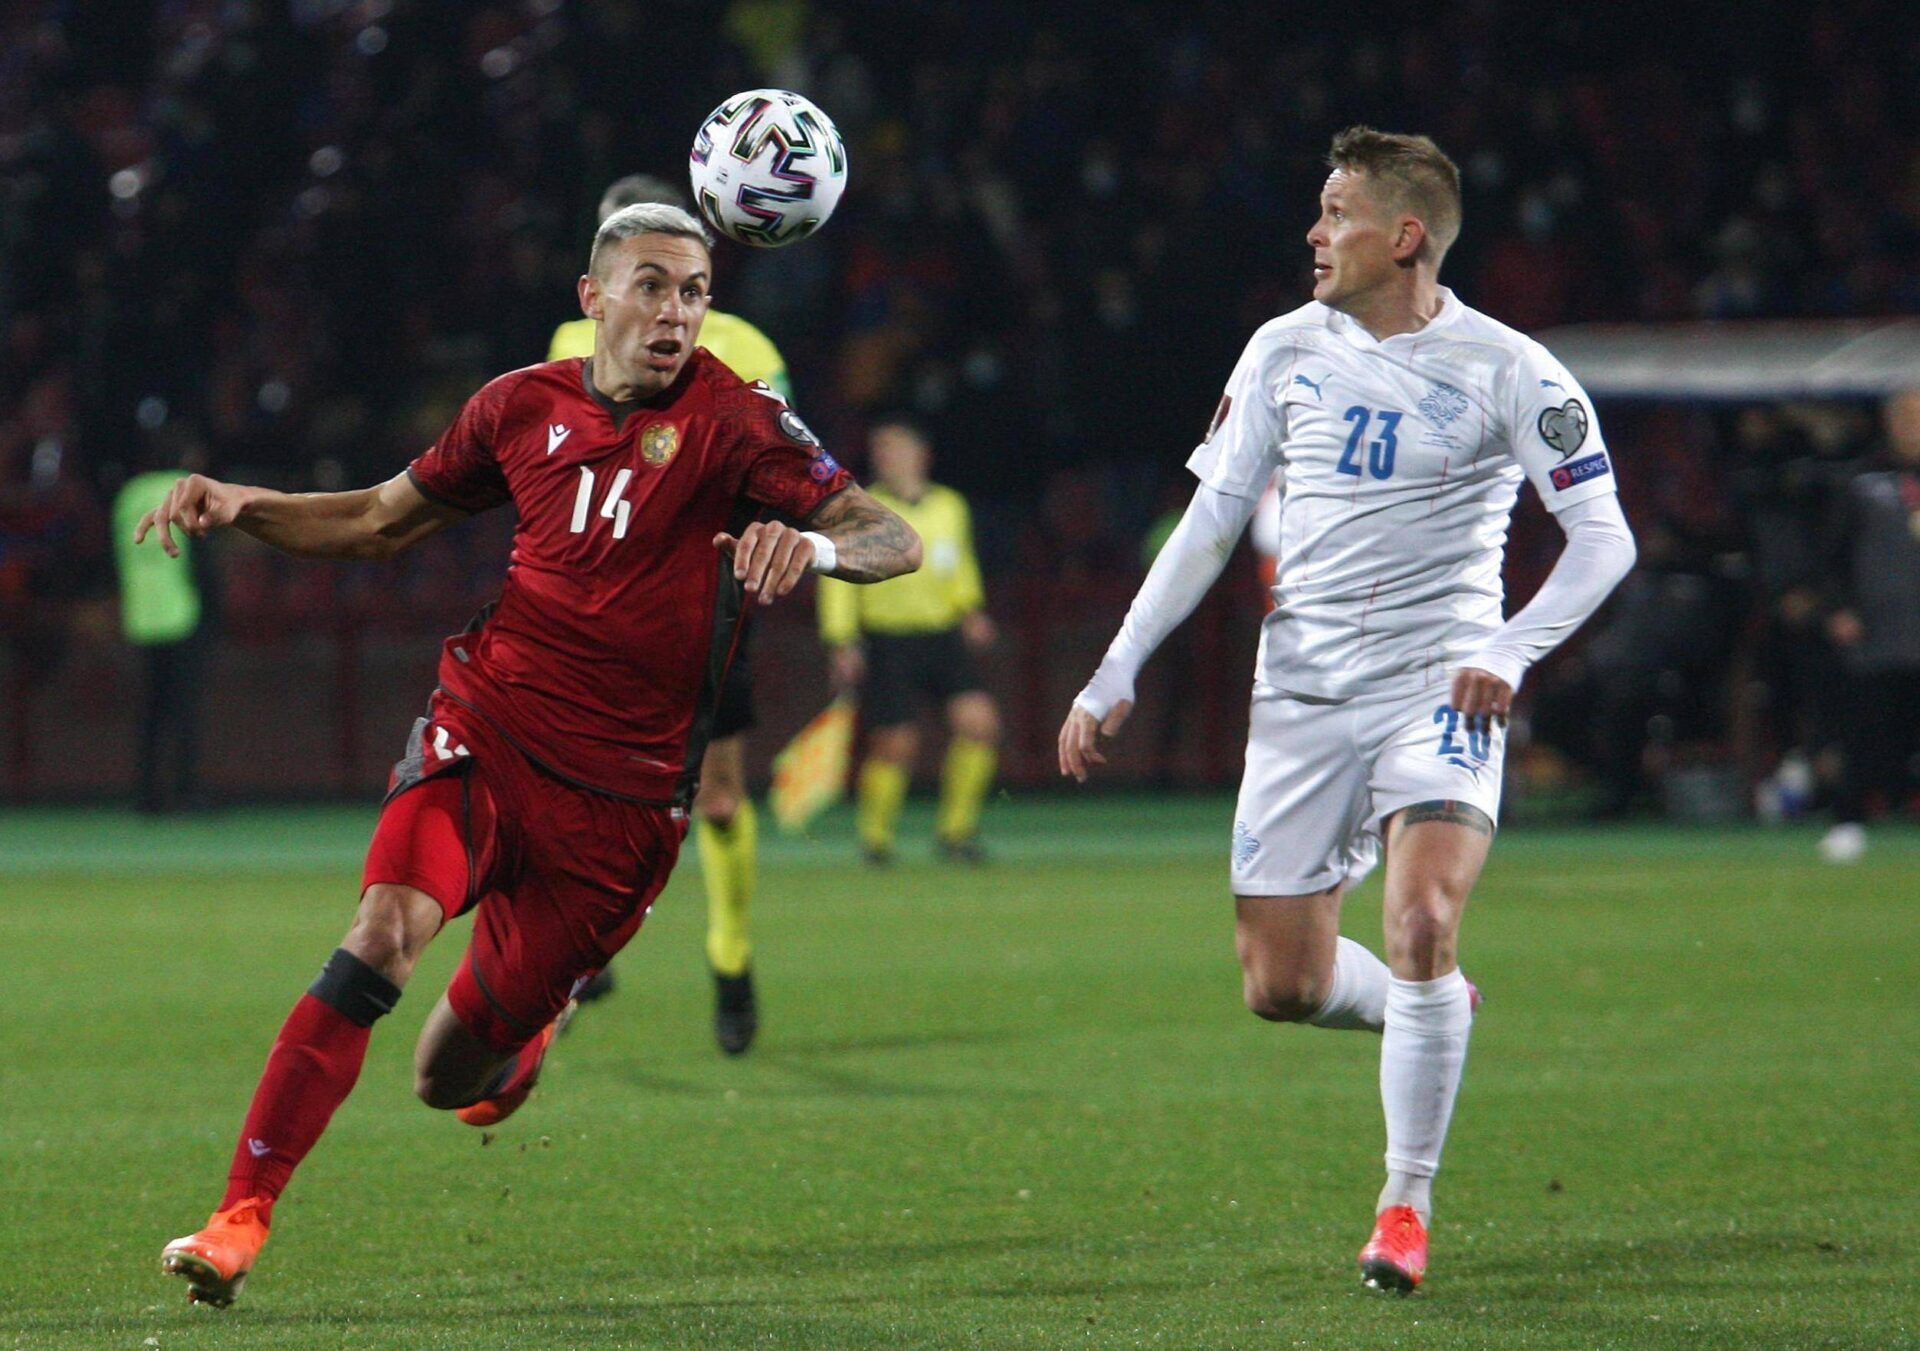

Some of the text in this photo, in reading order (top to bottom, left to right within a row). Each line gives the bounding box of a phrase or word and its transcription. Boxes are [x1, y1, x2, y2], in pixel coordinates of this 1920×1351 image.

[1336, 405, 1403, 480] 23
[1570, 457, 1607, 478] RESPEC
[569, 465, 632, 539] 14
